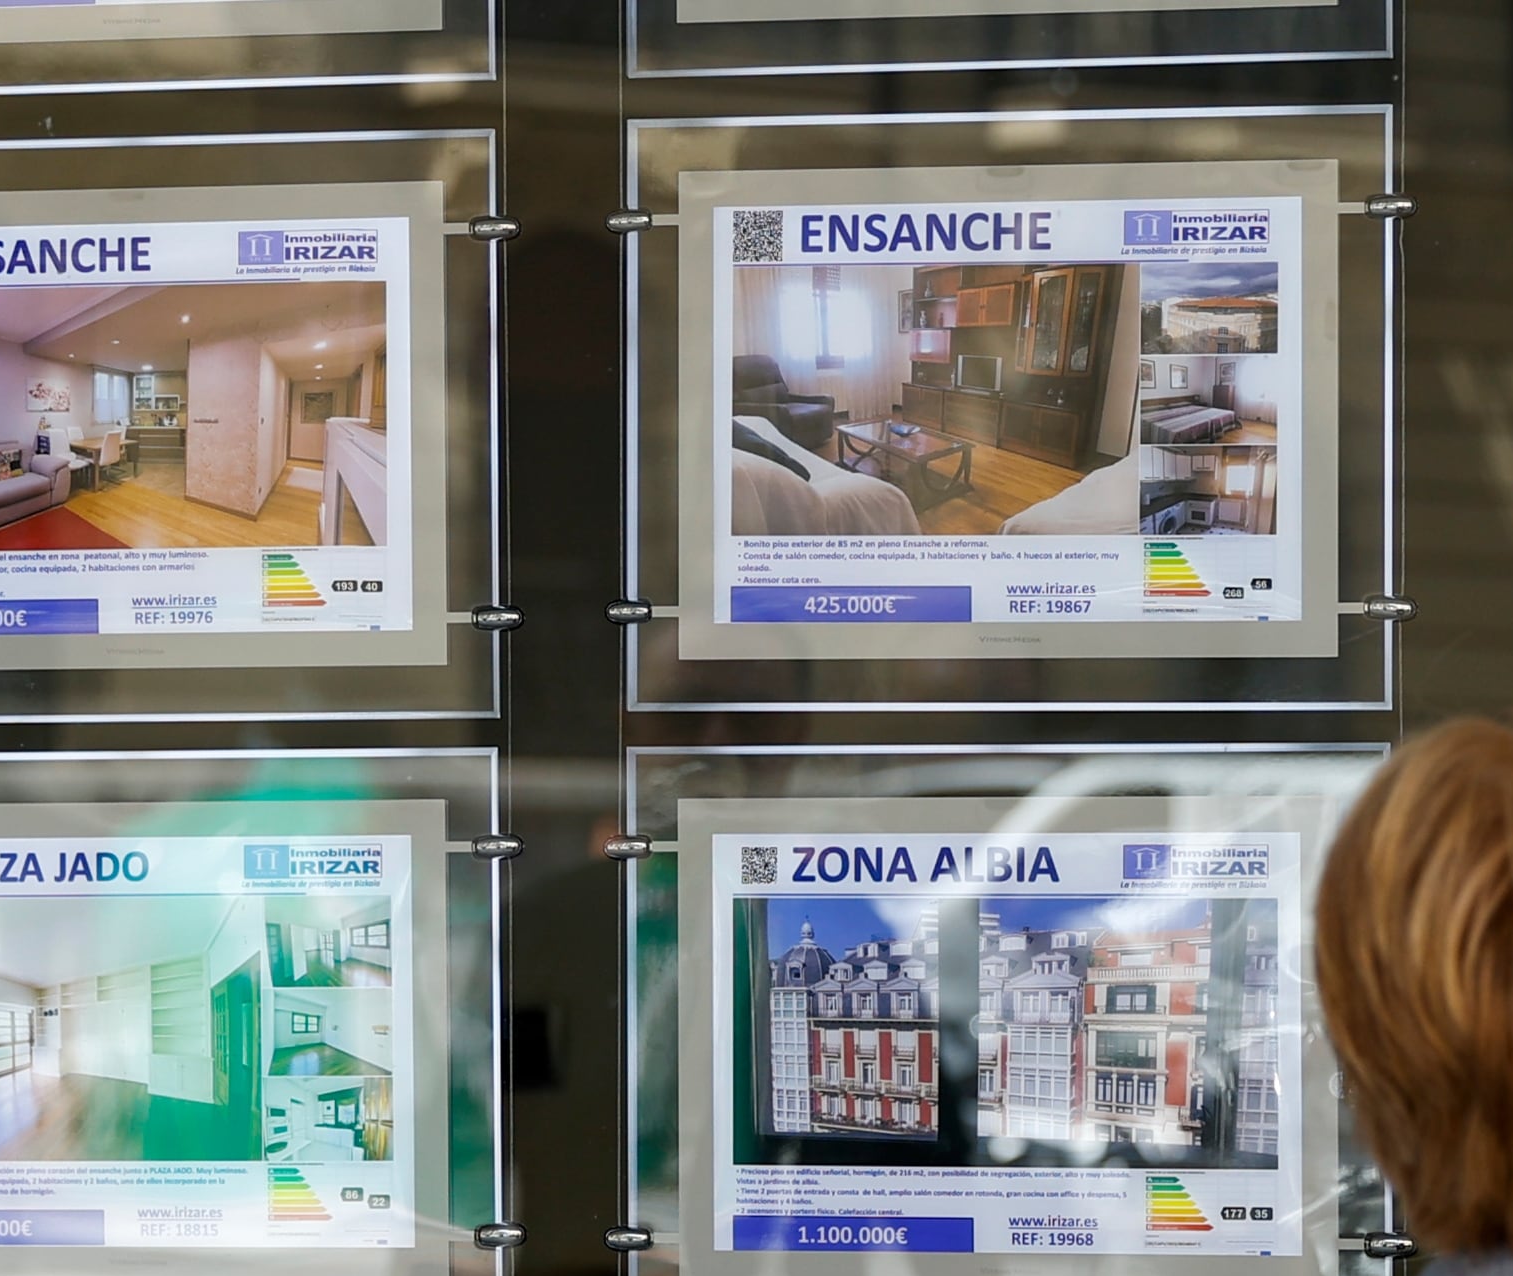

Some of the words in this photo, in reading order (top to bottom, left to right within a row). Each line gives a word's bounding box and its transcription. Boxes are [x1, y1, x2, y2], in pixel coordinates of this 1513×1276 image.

[1173, 213, 1268, 223] Inmobiliaria
[284, 233, 377, 243] Inmobiliaria
[801, 212, 1052, 252] ENSANCHE
[1173, 226, 1267, 241] IRIZAR
[284, 246, 376, 260] IRIZAR
[744, 540, 770, 548] Bonito
[772, 540, 790, 549] piso
[791, 540, 823, 548] exterior
[825, 540, 836, 548] de
[850, 540, 863, 548] m2
[878, 540, 901, 549] pleno
[903, 540, 941, 548] Ensanche
[951, 540, 989, 548] reformar.
[335, 581, 354, 590] 193
[365, 582, 378, 591] 40
[1006, 583, 1096, 595] www.irizar.es
[131, 593, 217, 605] www.irizar.es
[804, 596, 896, 614] 425.000€
[1010, 601, 1042, 613] REF:
[1046, 600, 1091, 613] 19867
[135, 612, 165, 624] REF:
[169, 611, 213, 624] 19976
[290, 848, 380, 858] Inmobiliaria
[1171, 848, 1267, 859] Inmobiliaria
[54, 851, 149, 883] JADO
[290, 860, 379, 874] IRIZAR
[792, 846, 917, 882] ZONA
[930, 846, 1059, 883] ALBIA
[1170, 860, 1266, 876] IRIZAR
[137, 1205, 222, 1218] www.irizar.es
[1223, 1209, 1244, 1218] 177
[1254, 1209, 1268, 1218] 35
[1008, 1215, 1098, 1227] www.irizar.es
[141, 1224, 171, 1236] REF:
[798, 1226, 908, 1244] 1.100.000€
[1012, 1233, 1043, 1245] REF:
[1048, 1232, 1094, 1245] 19968
